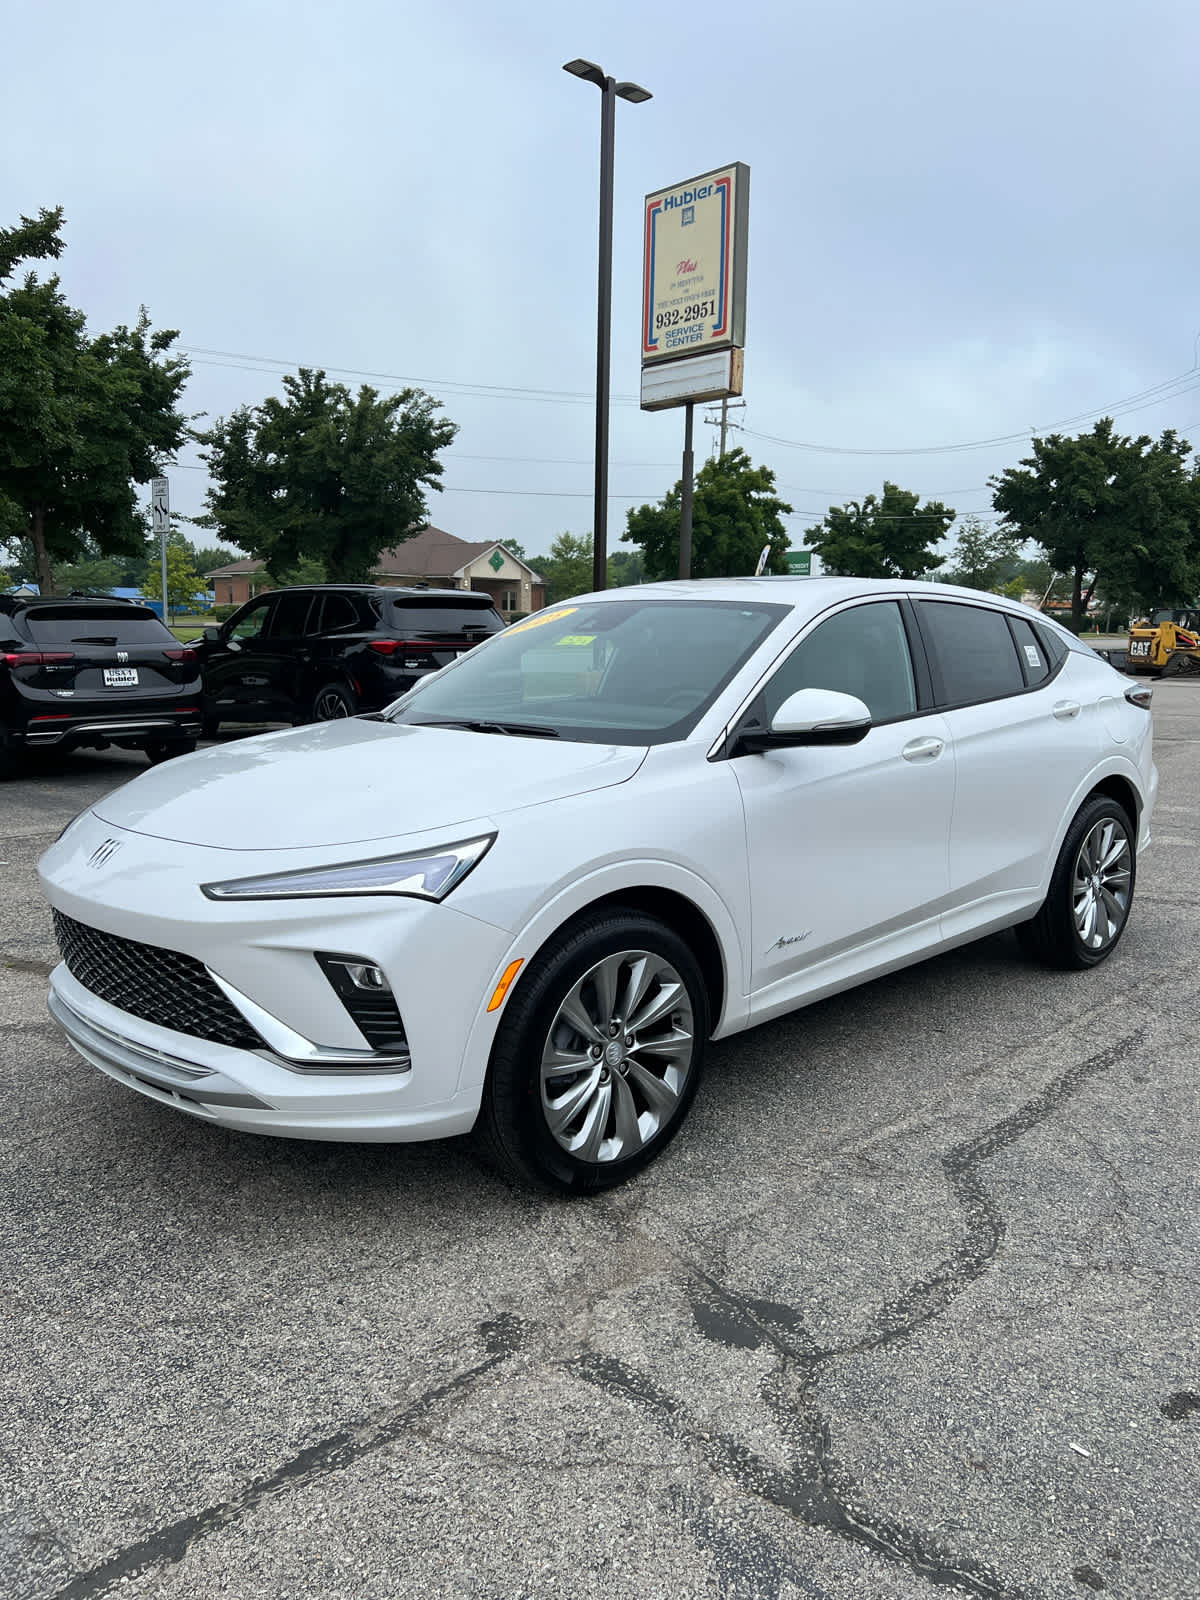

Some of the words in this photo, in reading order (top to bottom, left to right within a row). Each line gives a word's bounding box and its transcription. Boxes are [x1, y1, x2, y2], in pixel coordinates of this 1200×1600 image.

[663, 184, 714, 211] Hubler
[656, 299, 716, 329] 932-2951
[665, 323, 704, 339] SERVICE
[666, 332, 702, 348] CENTER
[1130, 641, 1151, 656] CAT
